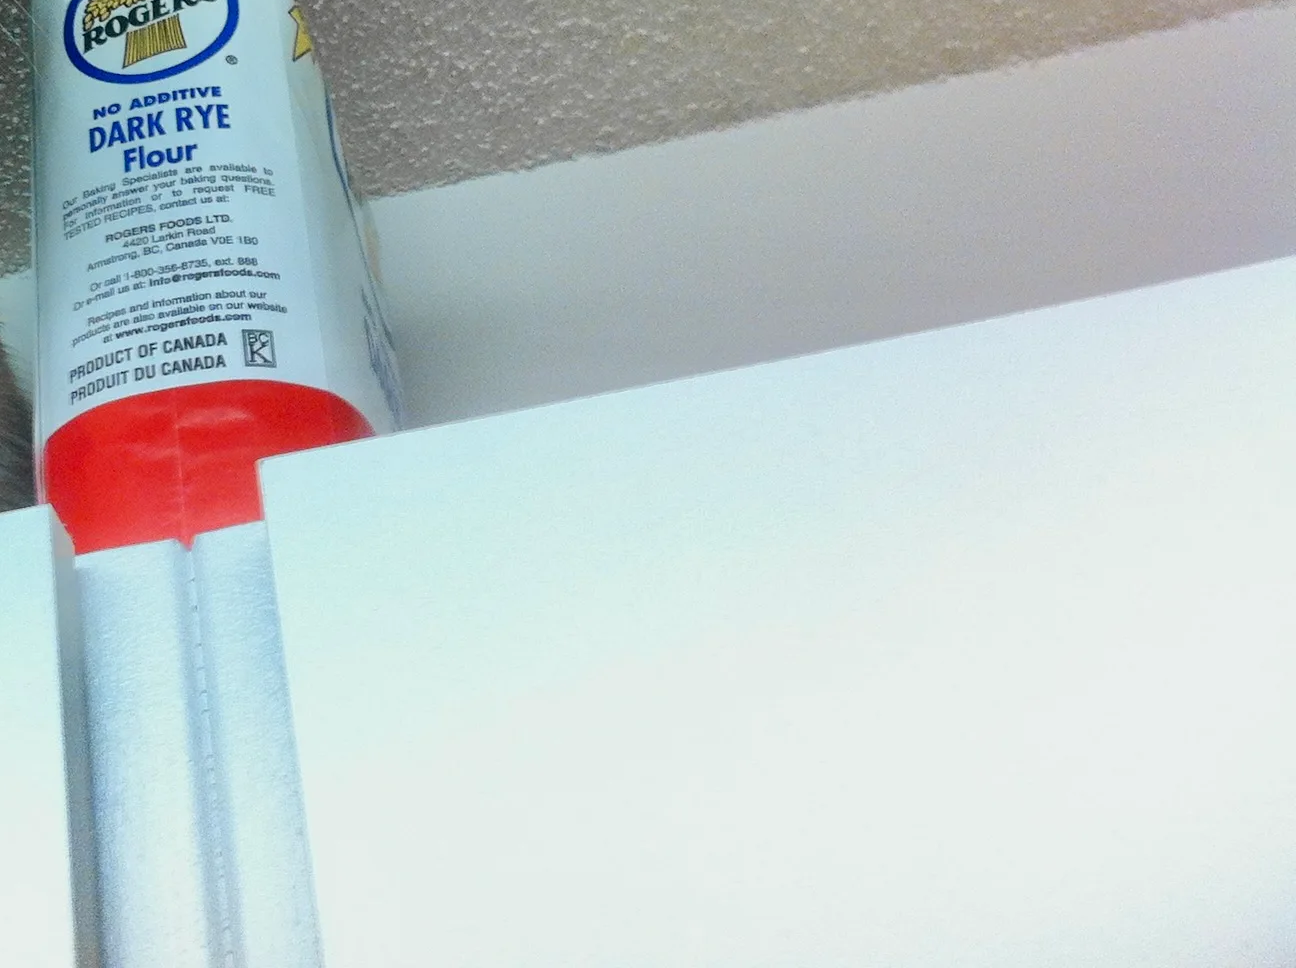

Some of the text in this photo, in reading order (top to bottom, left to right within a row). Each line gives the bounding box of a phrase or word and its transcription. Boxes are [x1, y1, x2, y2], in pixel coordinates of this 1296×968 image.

[93, 86, 222, 120] NO ADDITIVE
[89, 104, 231, 153] DARK RYE
[123, 143, 198, 173] Flour
[63, 195, 108, 221] personally
[112, 185, 149, 200] answer
[153, 179, 176, 192] your
[180, 175, 216, 185] baking
[83, 182, 116, 199] Baking
[122, 168, 178, 186] Specialists
[185, 166, 203, 174] are
[209, 163, 257, 173] available
[264, 167, 274, 176] to
[64, 217, 102, 240] TESTED
[159, 197, 197, 211] contact
[200, 196, 213, 204] us
[85, 197, 141, 219] information
[151, 193, 163, 201] or
[172, 189, 183, 198] to
[193, 185, 235, 195] request
[245, 184, 277, 197] FREE
[105, 214, 234, 243] ROGERS FOODS LTD.
[122, 226, 216, 248] 4420 Larkin Road
[87, 250, 141, 272] Armstrong,
[165, 239, 208, 252] Canada
[86, 287, 116, 306] e-mail
[117, 285, 130, 295] us
[90, 282, 103, 292] Or
[104, 274, 122, 288] call
[71, 301, 288, 349] products are also available on our website
[87, 289, 267, 327] Recipes and information about our
[115, 313, 252, 340] www.rogersfoods.com
[68, 331, 228, 385] PRODUCT OF CANADA
[70, 354, 227, 406] PRODUIT DU CANADA
